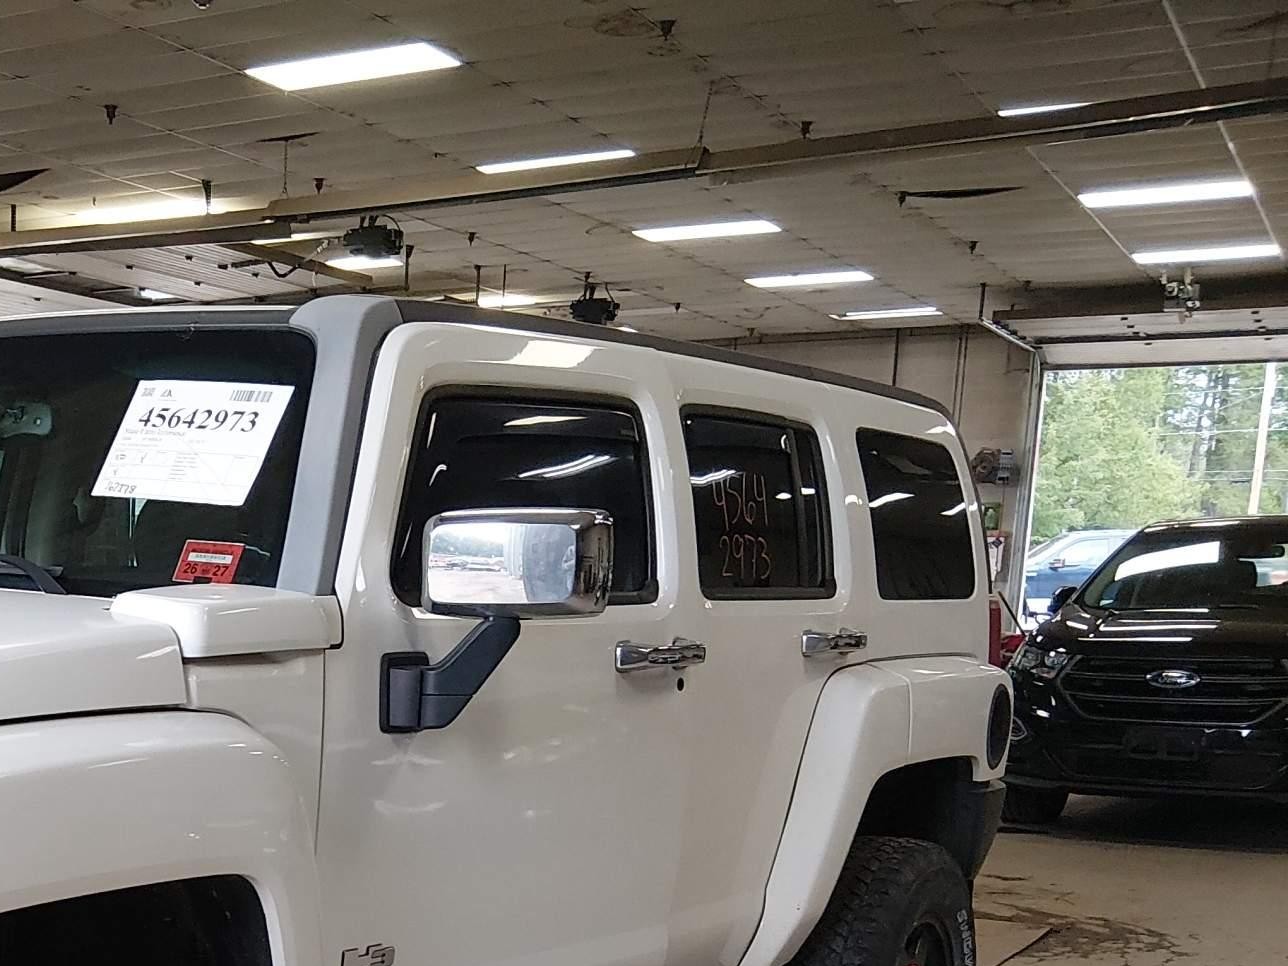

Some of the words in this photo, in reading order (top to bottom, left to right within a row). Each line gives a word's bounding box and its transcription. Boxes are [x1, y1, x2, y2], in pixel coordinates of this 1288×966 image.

[138, 406, 260, 433] 45642973
[712, 471, 769, 531] 4564
[182, 562, 199, 575] 26
[212, 565, 230, 577] 27
[719, 534, 772, 579] 2973
